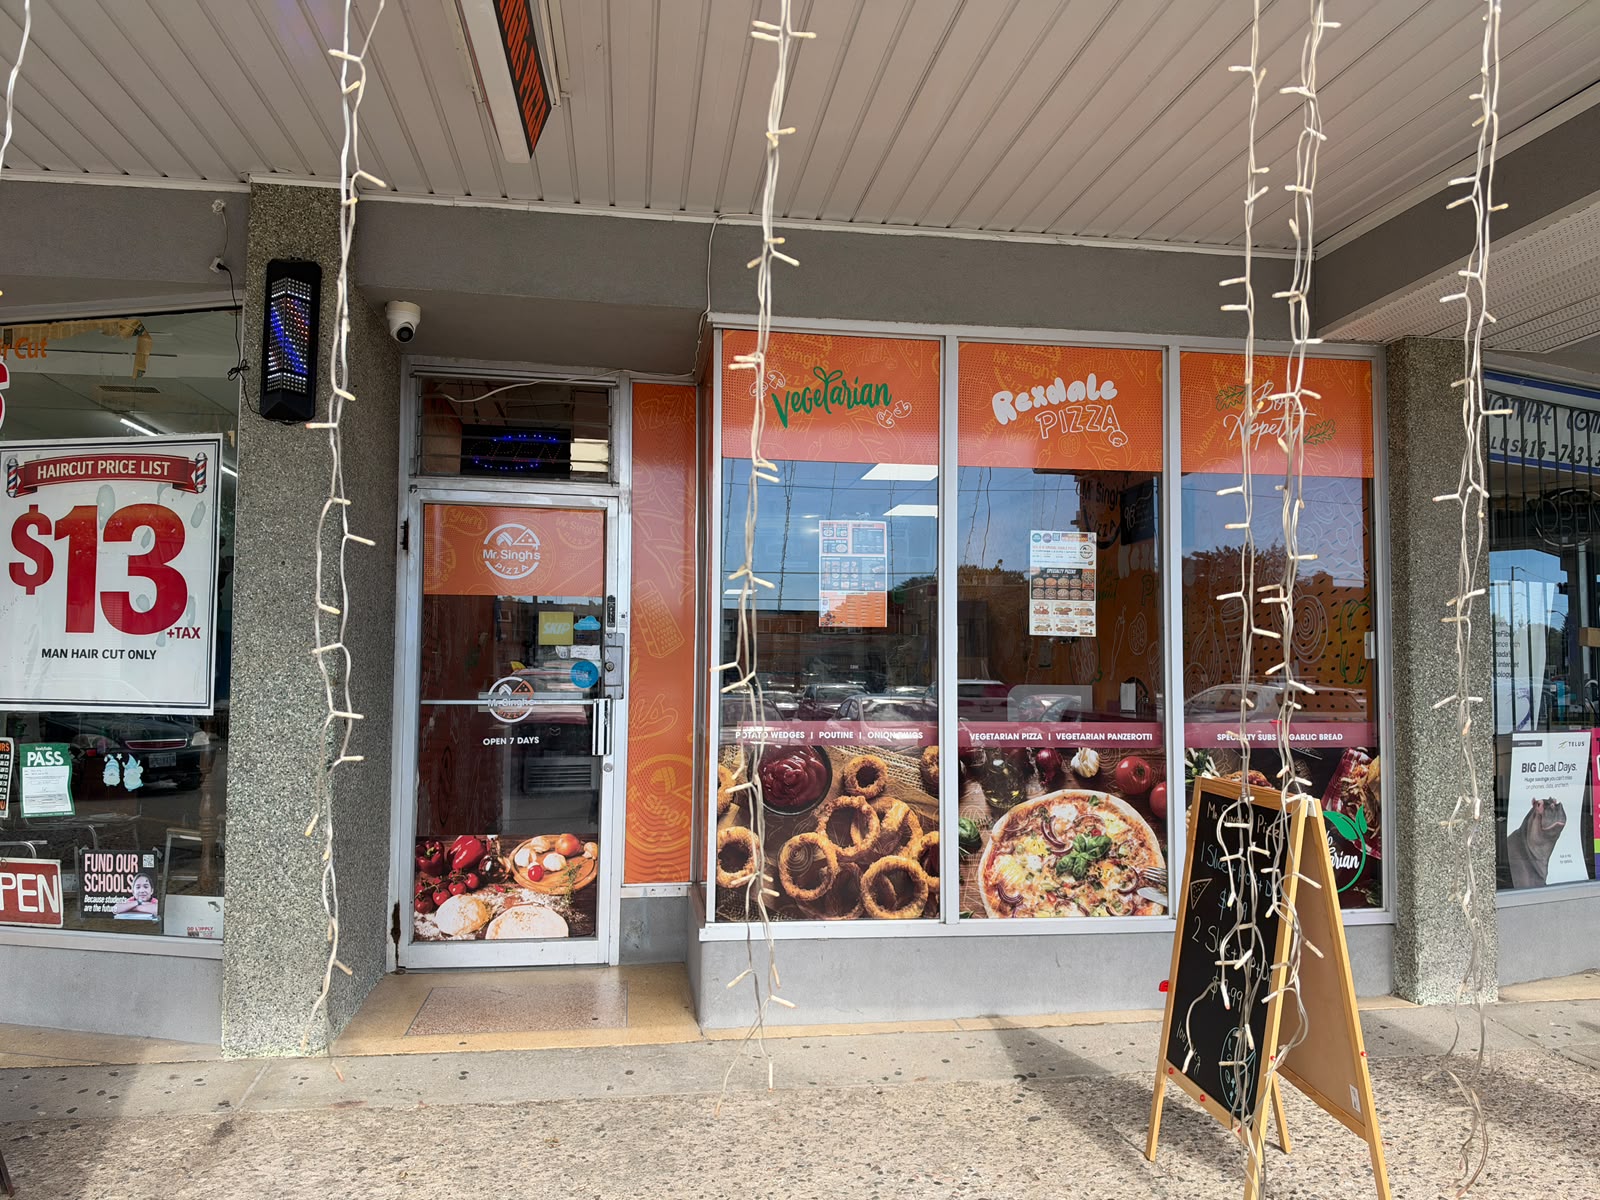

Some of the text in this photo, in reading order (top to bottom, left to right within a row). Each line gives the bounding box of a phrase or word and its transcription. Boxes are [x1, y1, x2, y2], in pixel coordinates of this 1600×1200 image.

[14, 336, 48, 360] Cut
[992, 373, 1118, 425] Rexdale
[1035, 404, 1121, 440] PIZZA
[37, 460, 170, 480] HAIRCUT PRICE LIST
[9, 503, 188, 636] $13
[494, 562, 529, 575] PIZZA
[167, 626, 201, 639] +TAX
[543, 622, 571, 635] SKIP
[41, 648, 157, 660] MAN HAIR CUT ONLY
[483, 736, 540, 746] OPEN 7 DAYS
[770, 731, 805, 739] WEDGES
[818, 731, 854, 739] POUTINE
[970, 732, 1153, 741] VEGETARIAN PIZZA VEGETARIAN PANZEROTTI
[1257, 733, 1277, 741] SUBS
[1288, 733, 1317, 741] GARLIC
[1319, 733, 1343, 741] BREAD
[27, 751, 64, 767] PASS
[1521, 761, 1578, 774] BIG Deal Days.
[84, 853, 139, 873] FUND OUR
[84, 873, 134, 893] SCHOOLS
[84, 894, 127, 904] Because students
[93, 904, 101, 912] the
[1192, 916, 1201, 943] 2
